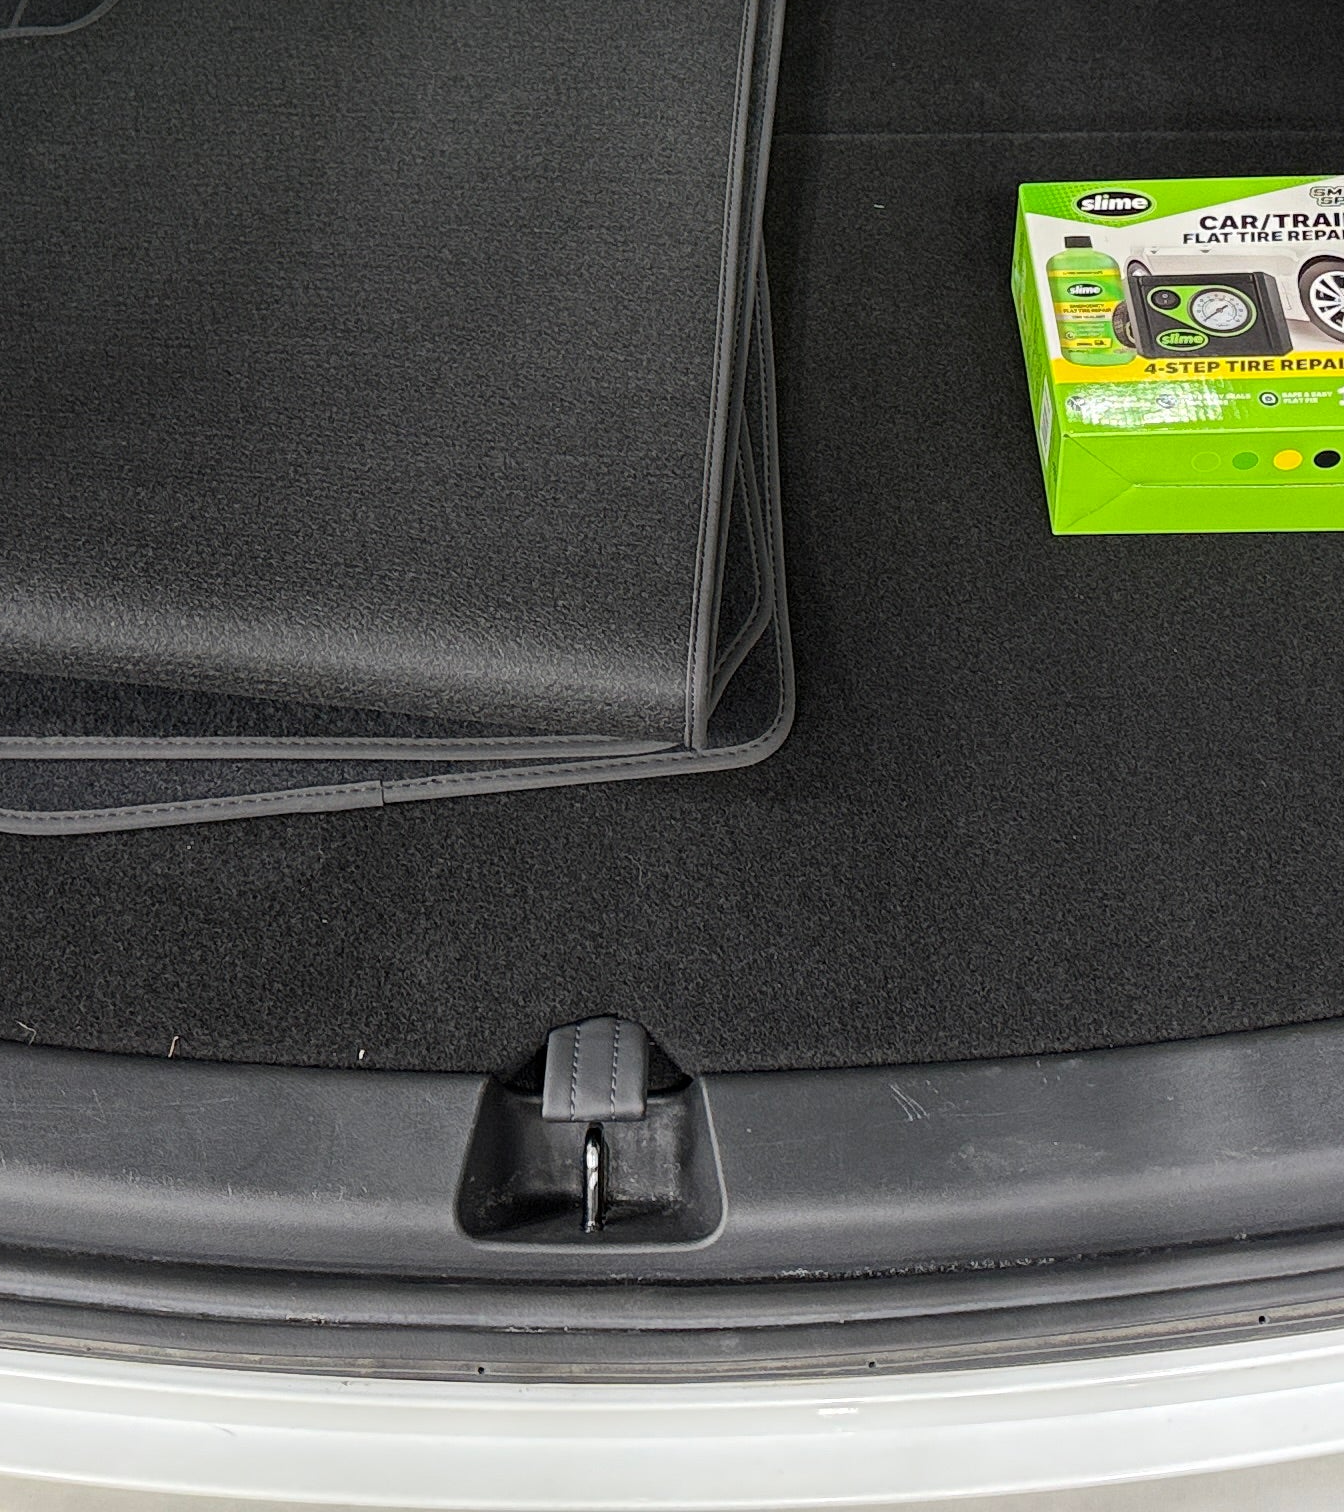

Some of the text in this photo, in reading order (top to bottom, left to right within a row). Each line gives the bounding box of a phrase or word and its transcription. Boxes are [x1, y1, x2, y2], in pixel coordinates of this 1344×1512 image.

[1080, 194, 1148, 211] slime
[1182, 232, 1234, 245] FLAT
[1236, 231, 1284, 243] TIRE
[1144, 360, 1220, 375] 4-STEP
[1225, 359, 1276, 373] TIRE
